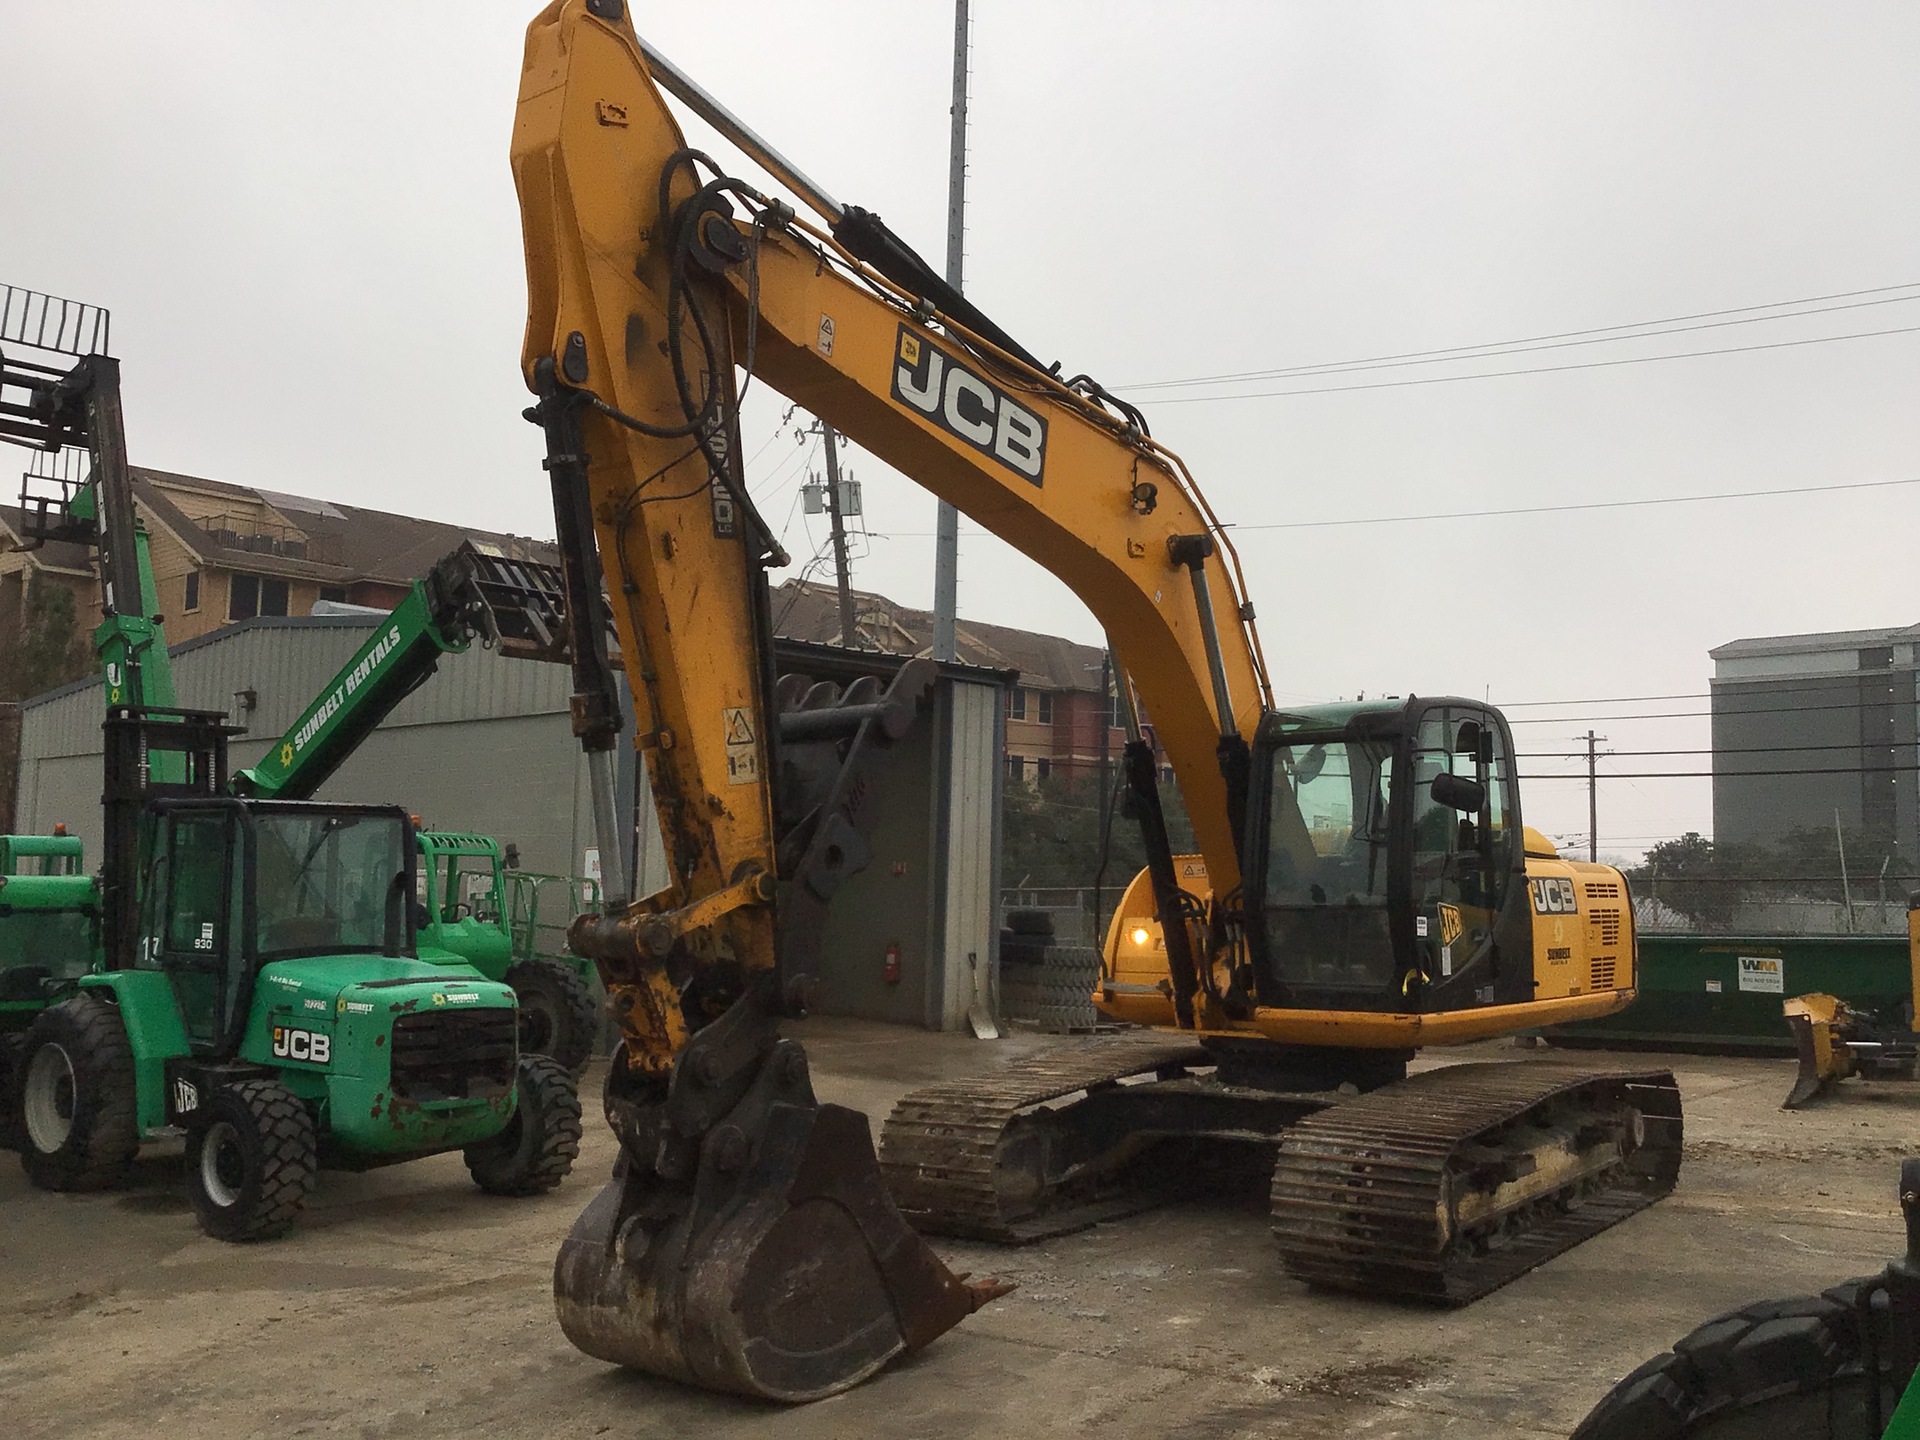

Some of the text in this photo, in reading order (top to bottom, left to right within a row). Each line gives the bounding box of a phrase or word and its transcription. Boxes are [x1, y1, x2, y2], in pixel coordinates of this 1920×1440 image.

[898, 350, 1043, 476] JCB
[294, 624, 401, 752] SUNBELT RENTALS
[1534, 879, 1577, 912] JCB
[1441, 906, 1461, 943] JCB
[194, 938, 213, 950] 930
[1741, 959, 1778, 972] WM
[446, 993, 479, 1001] SUNBELT
[273, 1029, 331, 1063] JCB
[177, 1080, 198, 1114] JCB
